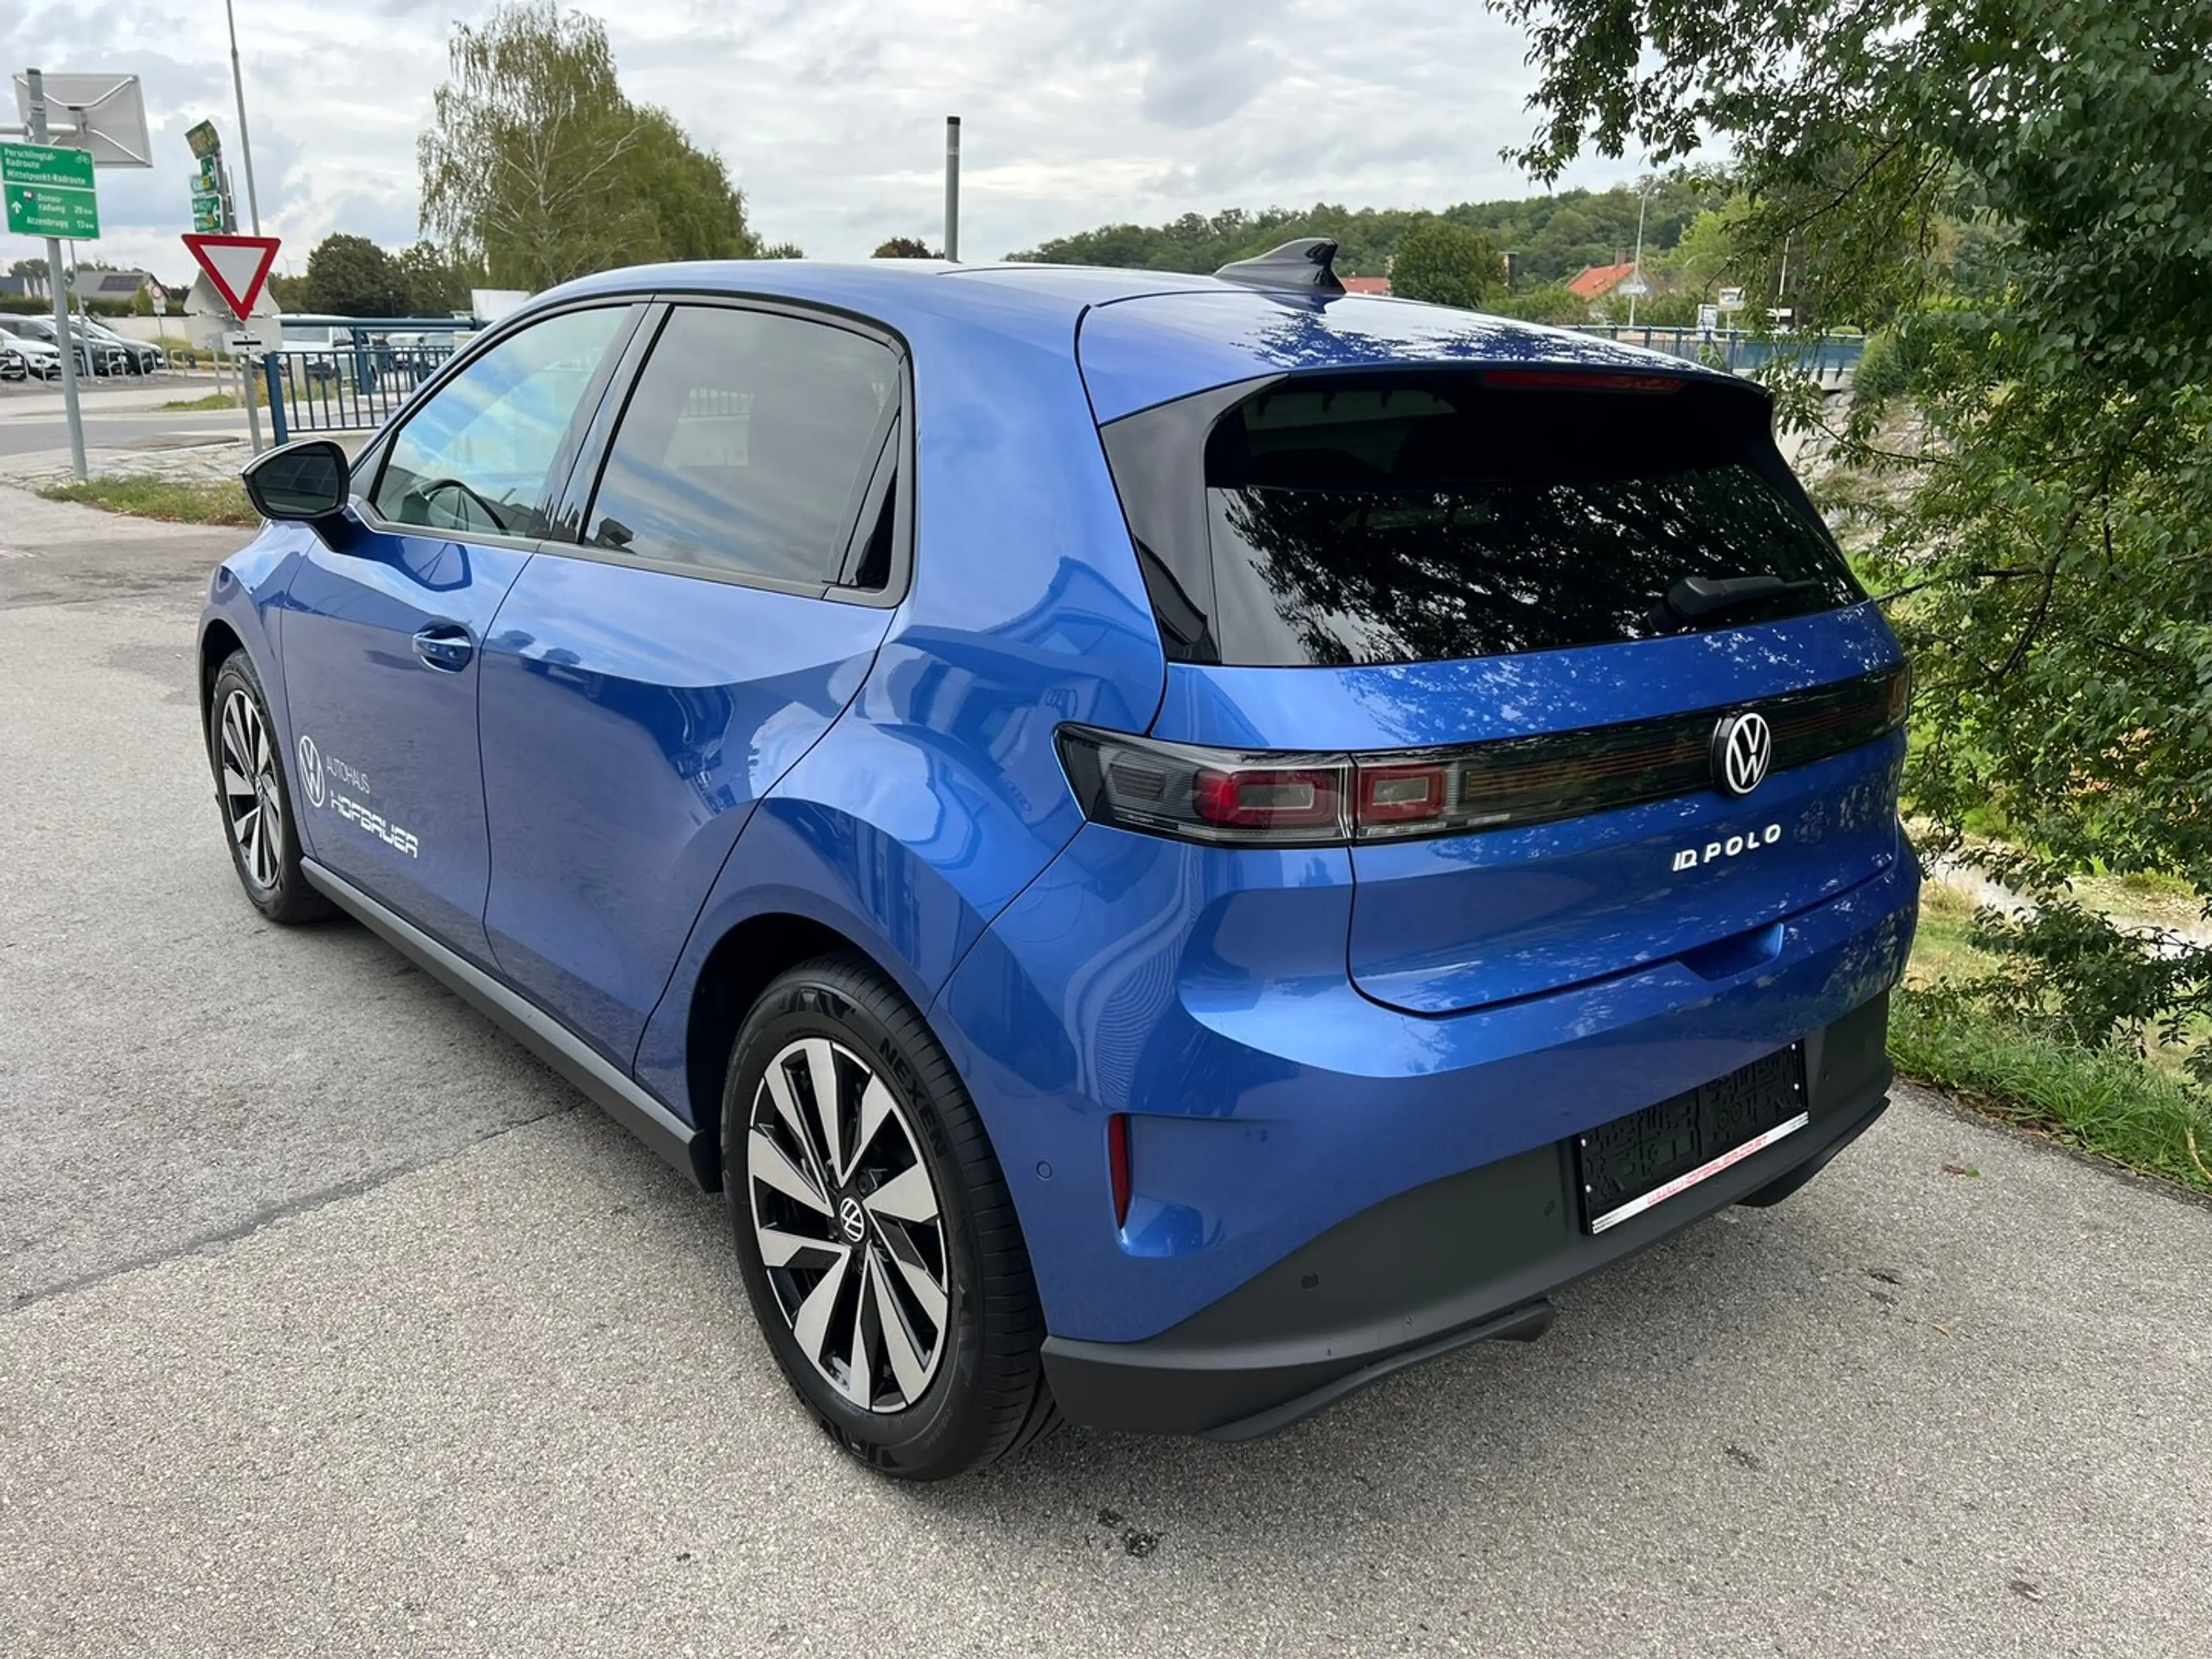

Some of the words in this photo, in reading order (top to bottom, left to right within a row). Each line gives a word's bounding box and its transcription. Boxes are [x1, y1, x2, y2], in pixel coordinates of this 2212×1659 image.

[6, 158, 40, 169] Radroute
[6, 169, 86, 185] Mittelpunkt-Radroute
[326, 755, 370, 794] AUTOHAUS
[330, 789, 419, 858] HOFBAUER
[1703, 823, 1782, 863] POLO
[879, 1037, 947, 1158] NEXEN
